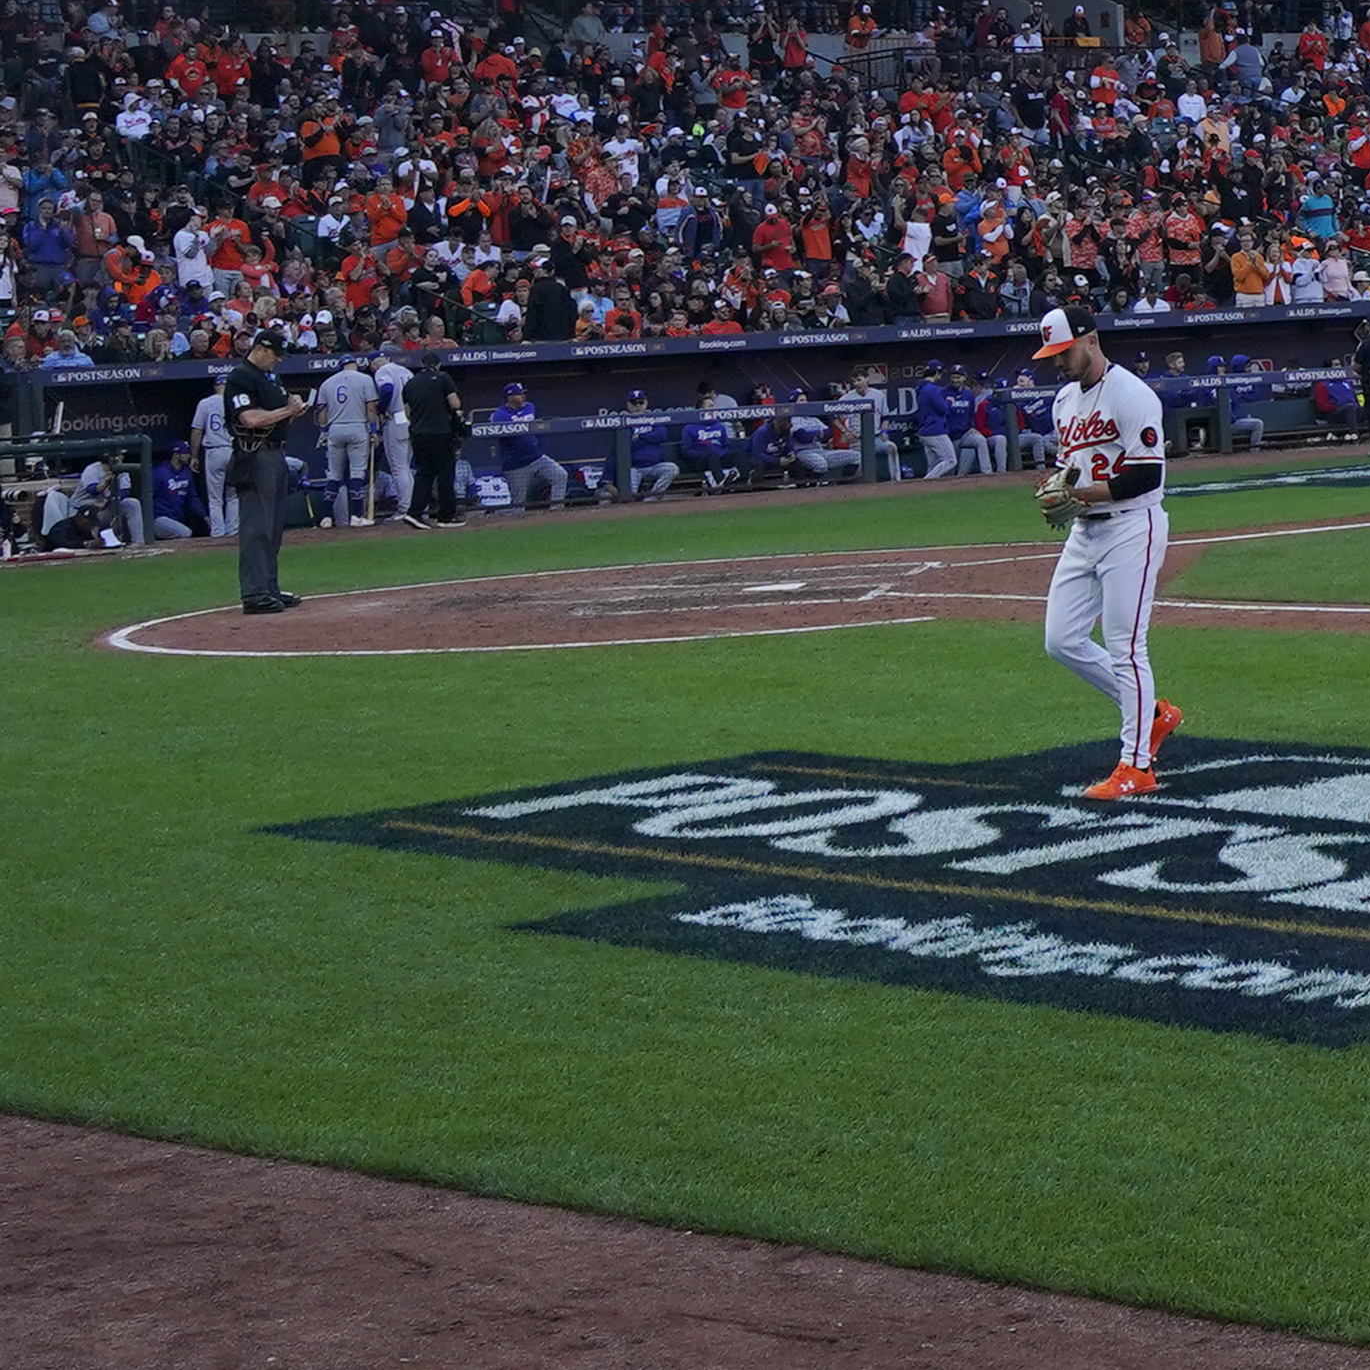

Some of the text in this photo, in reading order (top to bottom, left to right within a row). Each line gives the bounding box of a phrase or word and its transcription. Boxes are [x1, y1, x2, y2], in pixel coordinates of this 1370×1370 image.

[1113, 318, 1155, 329] Booking.com
[1193, 311, 1245, 323] POSTSEASON
[790, 332, 850, 345] POSTSEASON
[910, 329, 932, 339] ALDS
[583, 343, 648, 356] POSTSEASON
[699, 339, 747, 351] Booking.com
[460, 349, 538, 362] ALDS Booking.com
[68, 368, 142, 382] POSTSEASON
[1294, 369, 1347, 381] POSTSEASON
[1200, 377, 1222, 387] ALDS
[233, 392, 251, 410] 16
[336, 386, 348, 404] 6
[1010, 390, 1057, 401] Booking.com
[712, 407, 776, 420] POSTSEASON
[823, 400, 873, 414] Booking.com
[50, 411, 169, 434] ooking.com
[594, 417, 621, 429] ALDS
[471, 422, 531, 437] STSEASON
[1146, 430, 1157, 444] S
